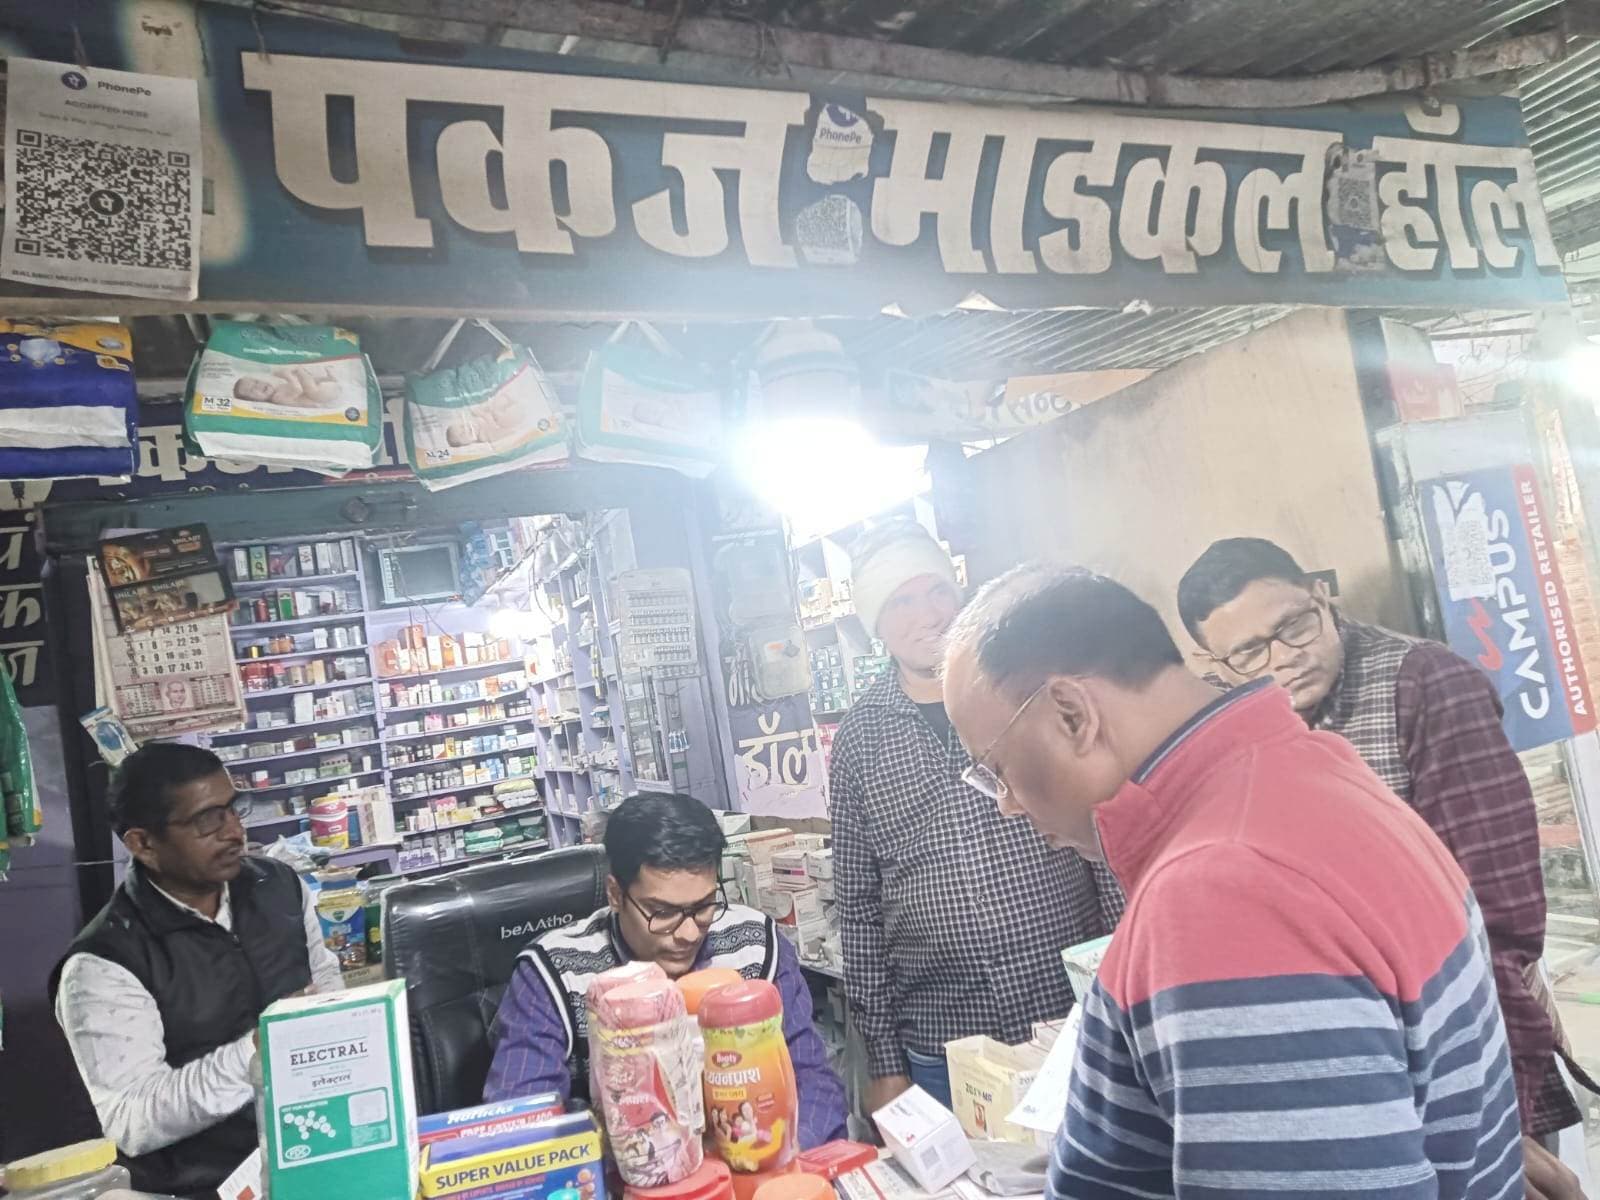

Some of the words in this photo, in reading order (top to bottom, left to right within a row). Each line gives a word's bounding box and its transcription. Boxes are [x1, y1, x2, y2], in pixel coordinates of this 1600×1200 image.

[97, 80, 152, 97] PhonePe
[819, 126, 863, 145] PhonePe
[203, 397, 214, 406] M
[215, 398, 231, 408] 32
[437, 449, 450, 459] 24
[1521, 480, 1553, 576] RETAILER
[1487, 508, 1550, 720] CAMPUS
[175, 625, 185, 635] 21
[177, 637, 186, 647] 22
[1544, 580, 1588, 717] AUTHORISED
[168, 663, 176, 673] 17
[180, 662, 191, 672] 24
[290, 1042, 368, 1066] ELECTRAL
[436, 1167, 490, 1190] SUPER
[493, 1152, 547, 1176] VALUE
[549, 1144, 592, 1164] PACK
